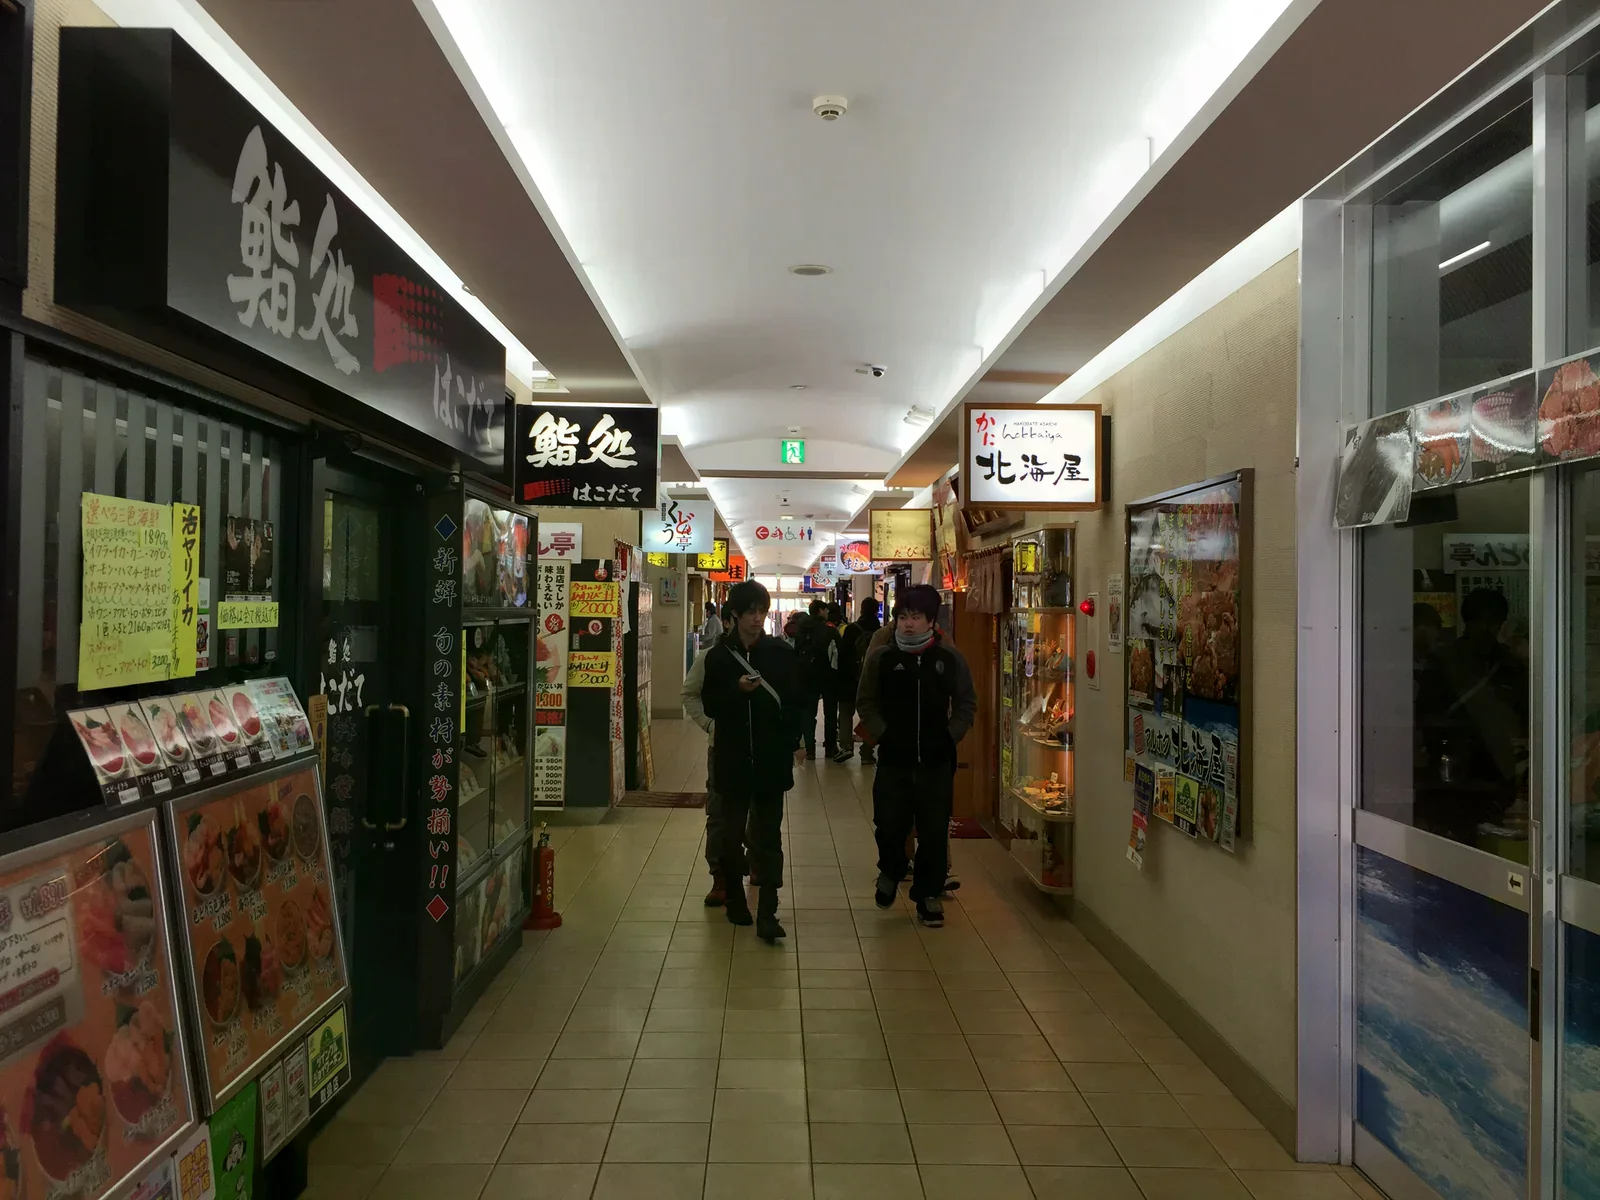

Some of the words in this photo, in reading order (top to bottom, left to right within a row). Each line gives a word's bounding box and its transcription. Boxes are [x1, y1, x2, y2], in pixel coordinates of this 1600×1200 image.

[226, 123, 361, 376] 鮨処
[525, 411, 639, 470] 鮨処
[975, 412, 996, 446] かに
[975, 450, 1089, 485] 北海屋
[572, 482, 643, 504] はこだて
[182, 507, 198, 627] 活ヤリイカ
[433, 546, 459, 608] 新鮮
[543, 565, 554, 610] 味わえない
[555, 565, 565, 611] 当店でしか
